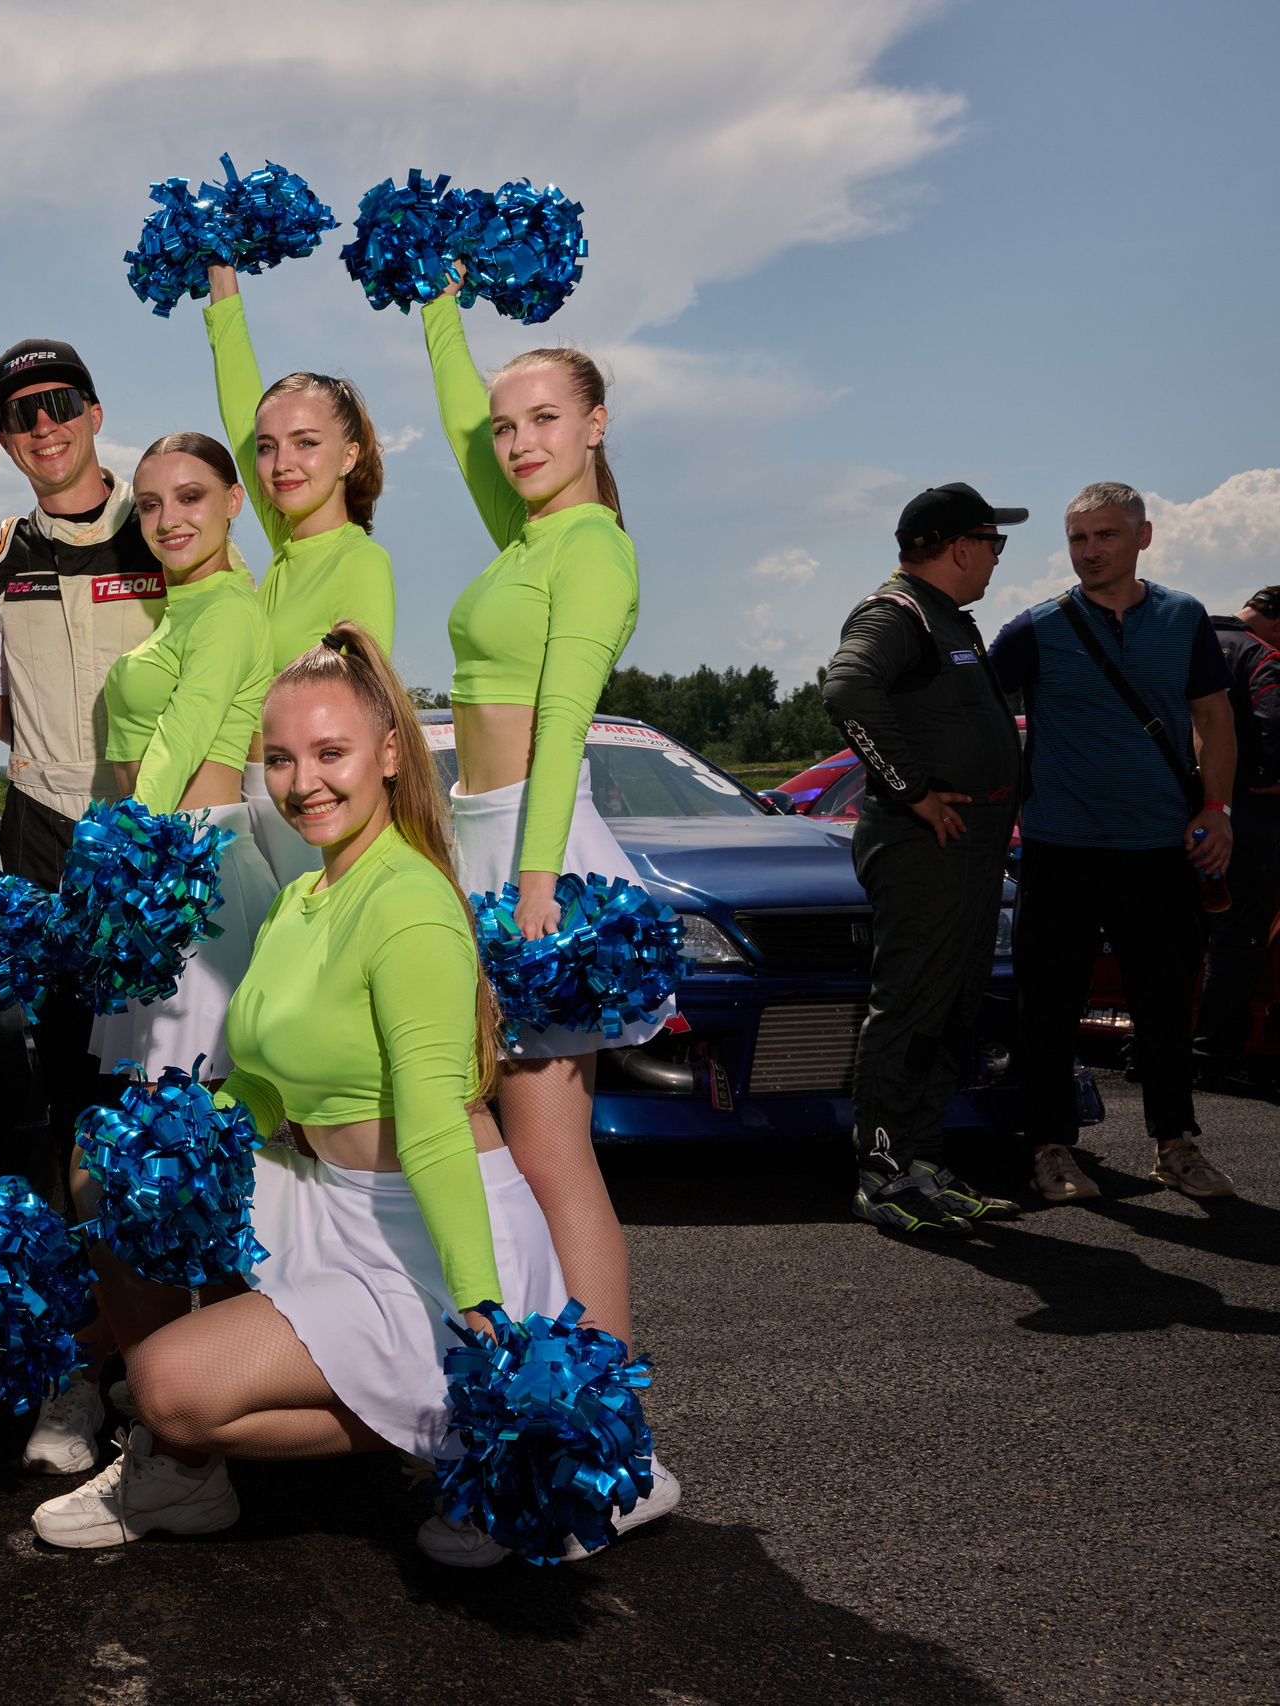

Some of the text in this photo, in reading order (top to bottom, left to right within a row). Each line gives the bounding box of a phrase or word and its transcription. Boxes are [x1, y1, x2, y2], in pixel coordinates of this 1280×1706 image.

[10, 351, 57, 368] HYPER
[10, 360, 36, 376] FUEL
[95, 577, 162, 597] TEBOIL
[614, 735, 648, 745] СЕЗОН
